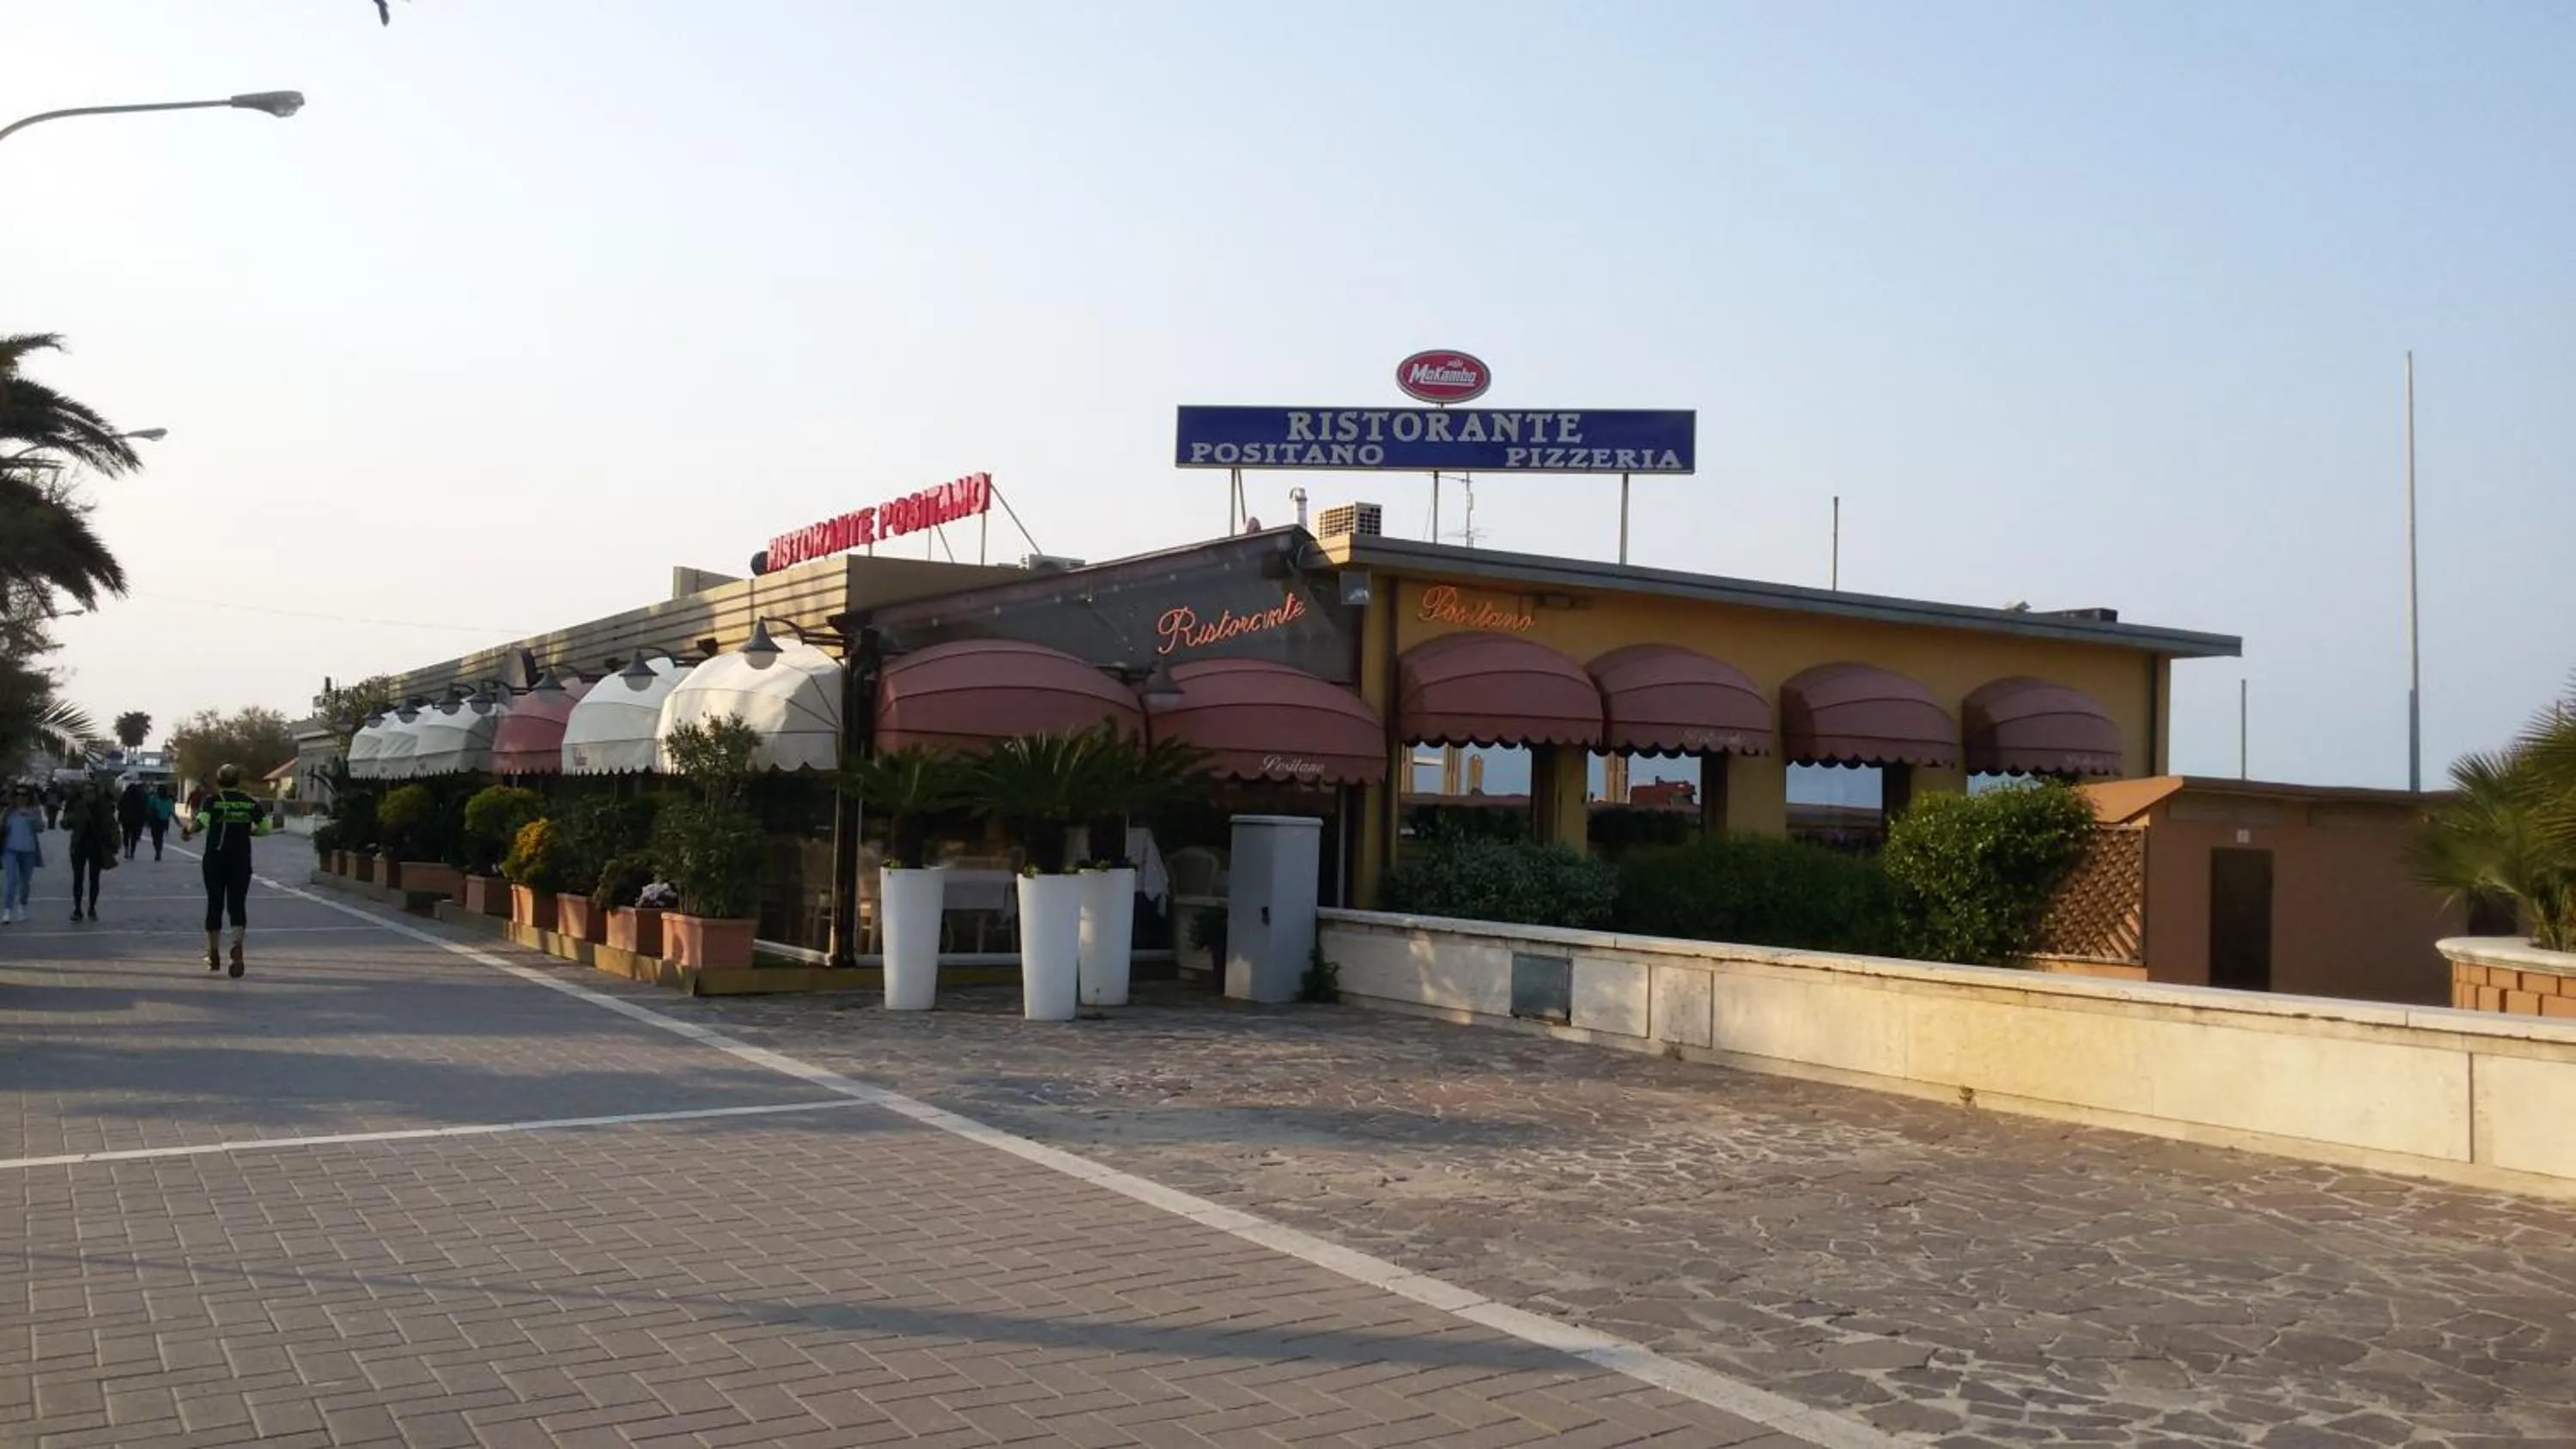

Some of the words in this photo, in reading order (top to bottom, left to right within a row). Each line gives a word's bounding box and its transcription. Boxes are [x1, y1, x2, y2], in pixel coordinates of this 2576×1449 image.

[1287, 411, 1583, 444] RISTORANTE
[1190, 443, 1384, 465] POSITANO
[1505, 447, 1683, 469] PIZZERIA
[766, 506, 876, 573] RISTORANTE
[878, 472, 992, 540] POSITANO
[1158, 591, 1306, 655] Ristorante
[1417, 585, 1535, 632] Positano
[1259, 754, 1325, 773] Positano
